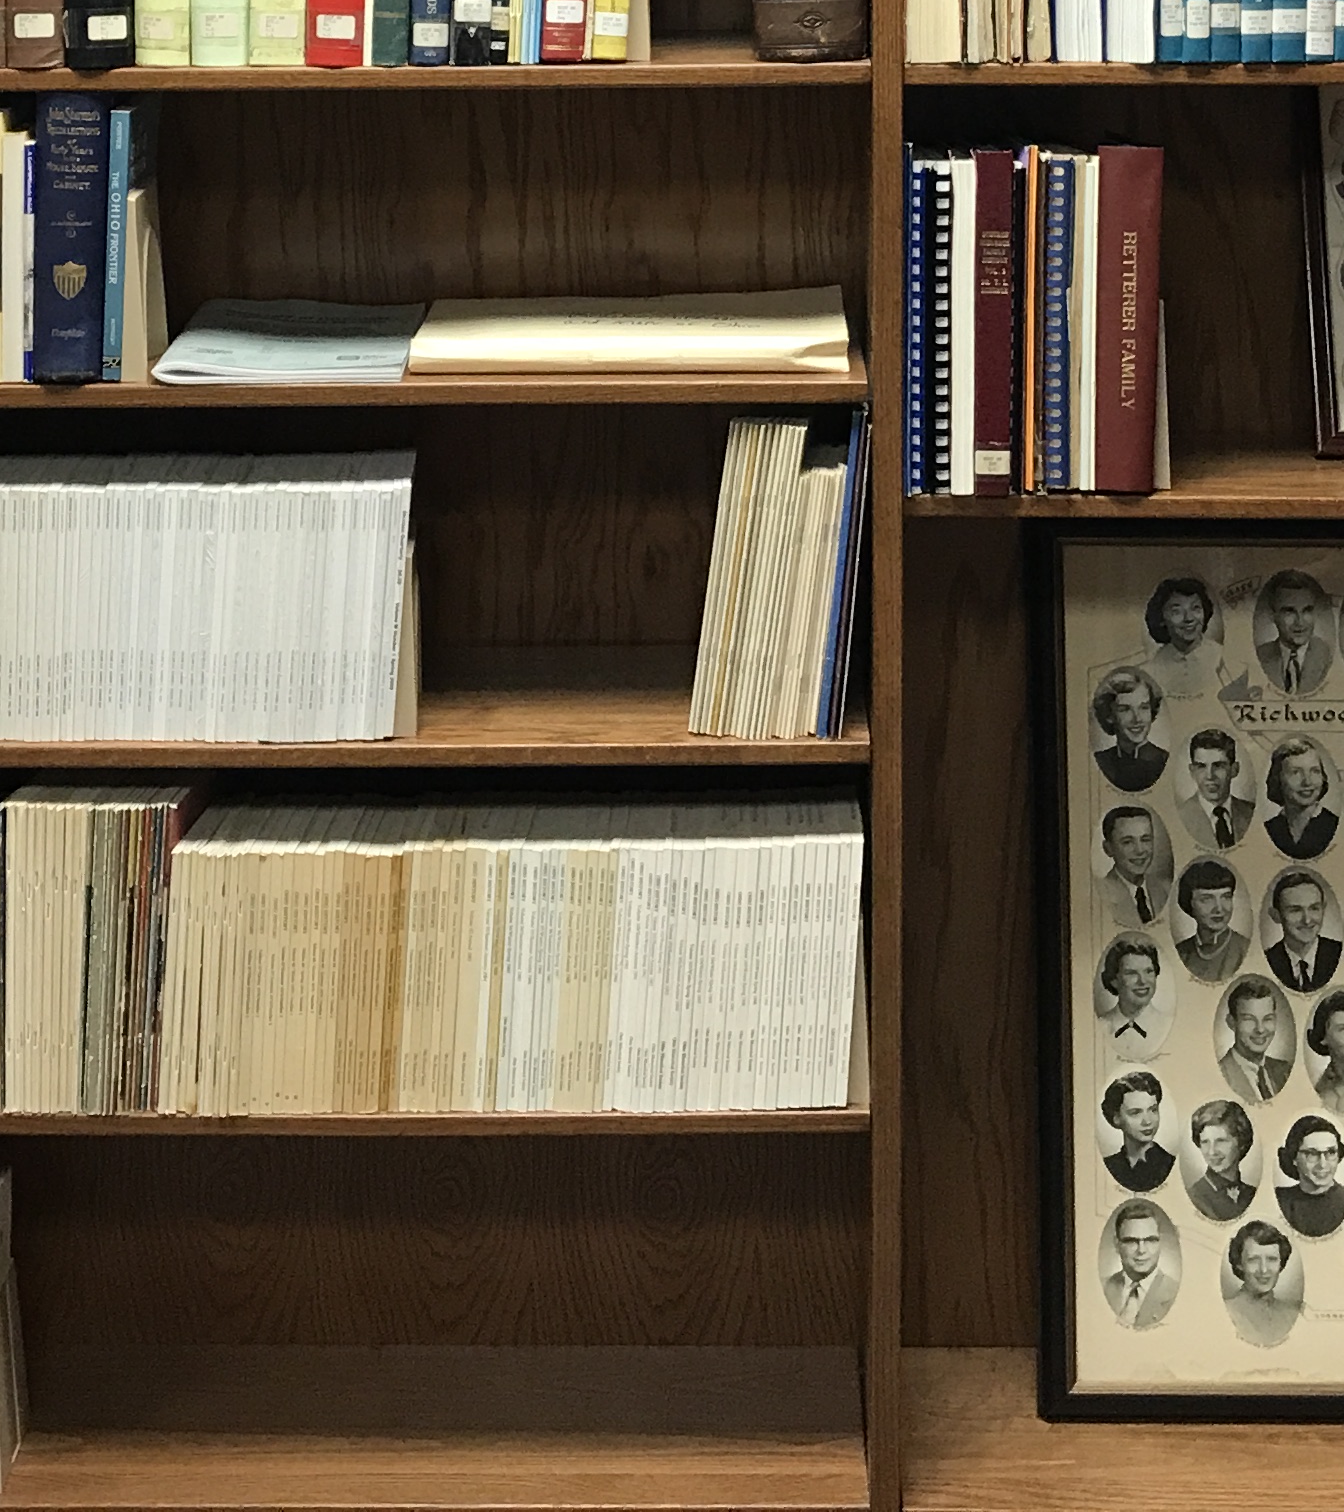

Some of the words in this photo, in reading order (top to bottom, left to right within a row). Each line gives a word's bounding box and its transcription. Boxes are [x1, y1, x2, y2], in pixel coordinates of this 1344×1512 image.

[111, 171, 121, 189] THE
[110, 191, 122, 231] OHIO
[108, 233, 119, 284] FRONTIER
[1122, 230, 1138, 331] RETTERER
[1120, 337, 1136, 411] FAMILY
